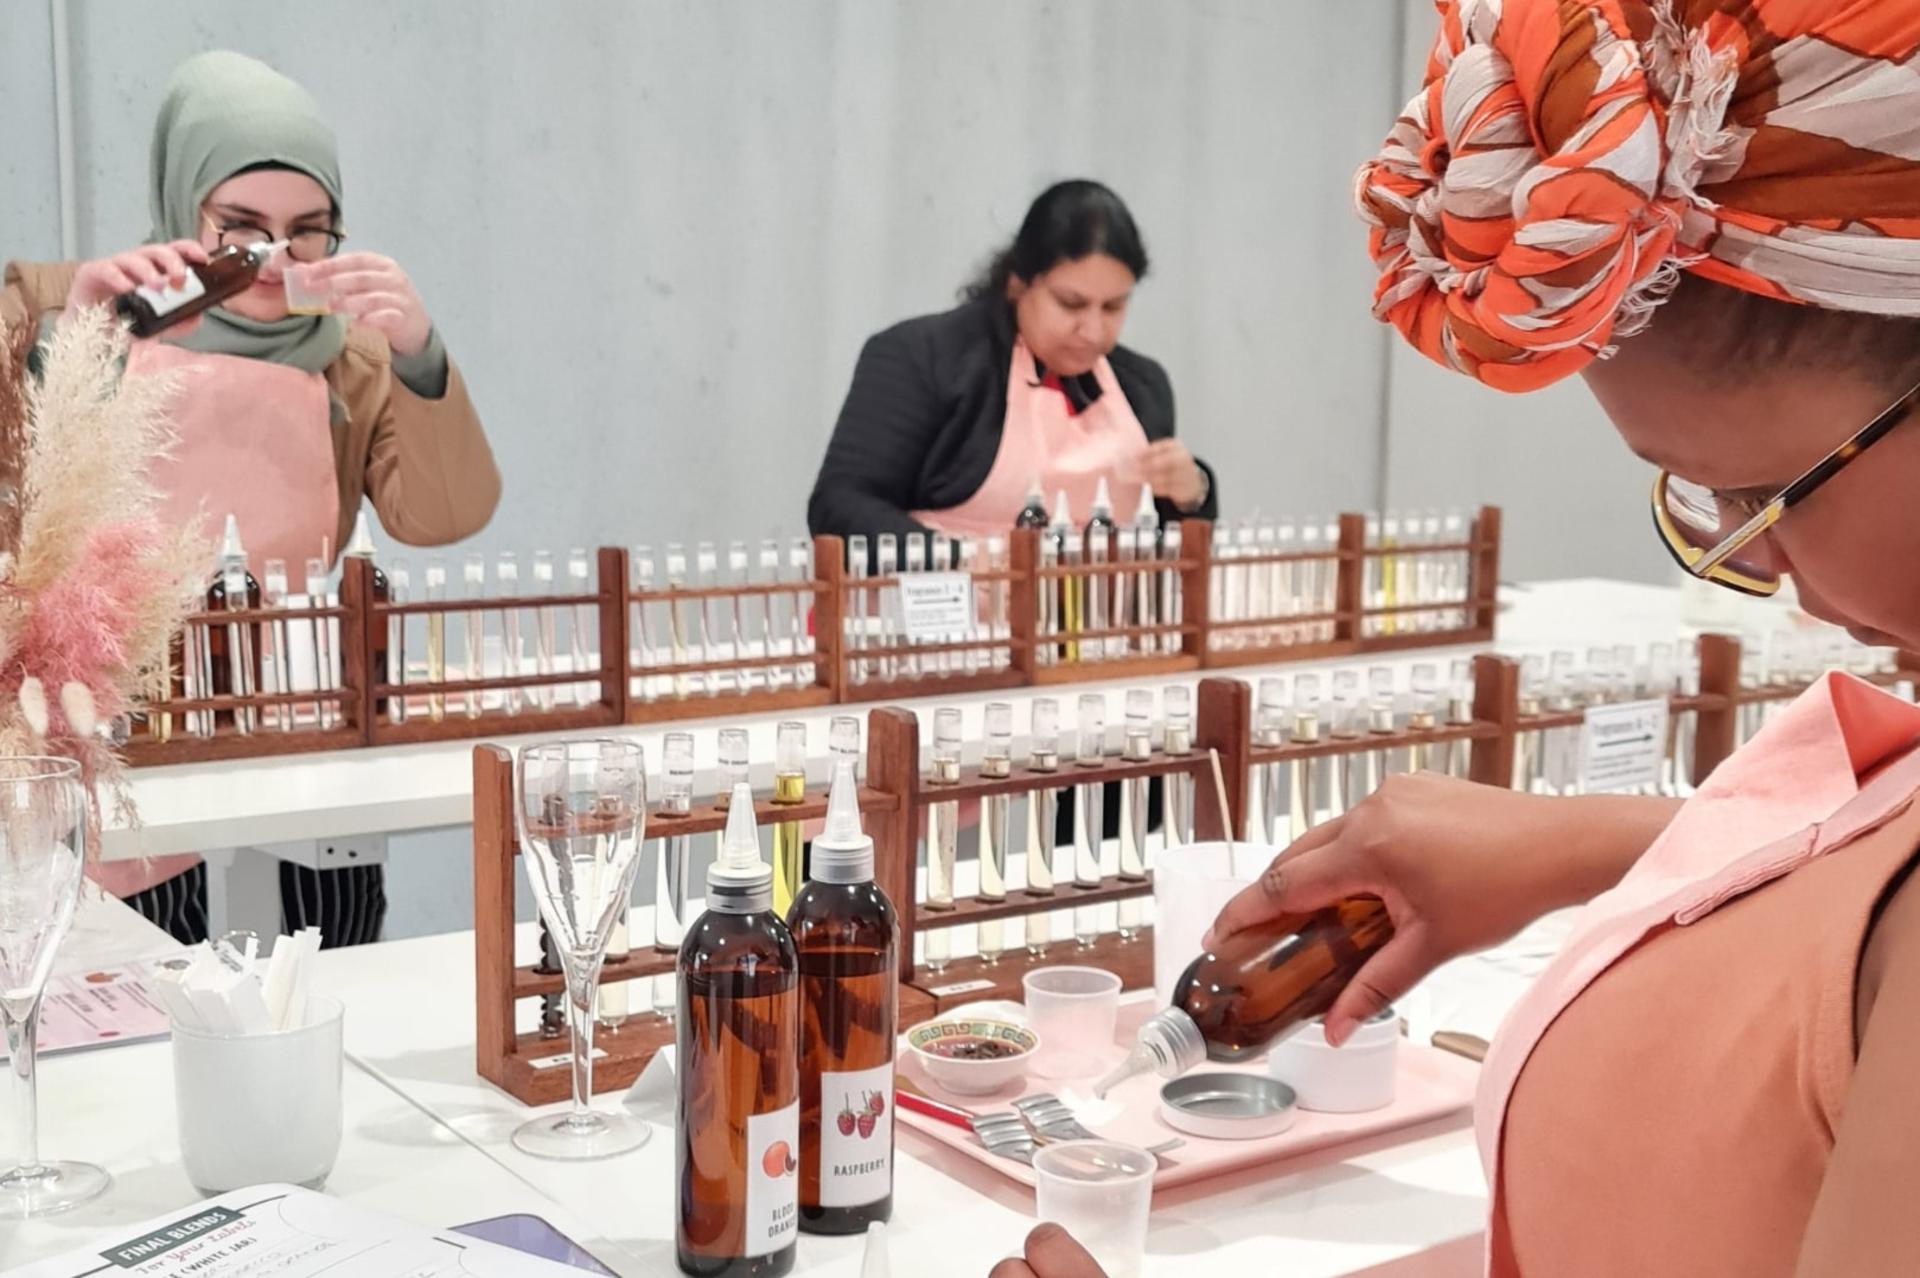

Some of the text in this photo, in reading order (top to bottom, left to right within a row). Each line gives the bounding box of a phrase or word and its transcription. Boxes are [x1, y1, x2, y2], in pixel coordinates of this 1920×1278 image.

[834, 1158, 885, 1177] RASPBERRY
[117, 1212, 228, 1260] FINAL BLENDS
[180, 1250, 230, 1274] (WHITE
